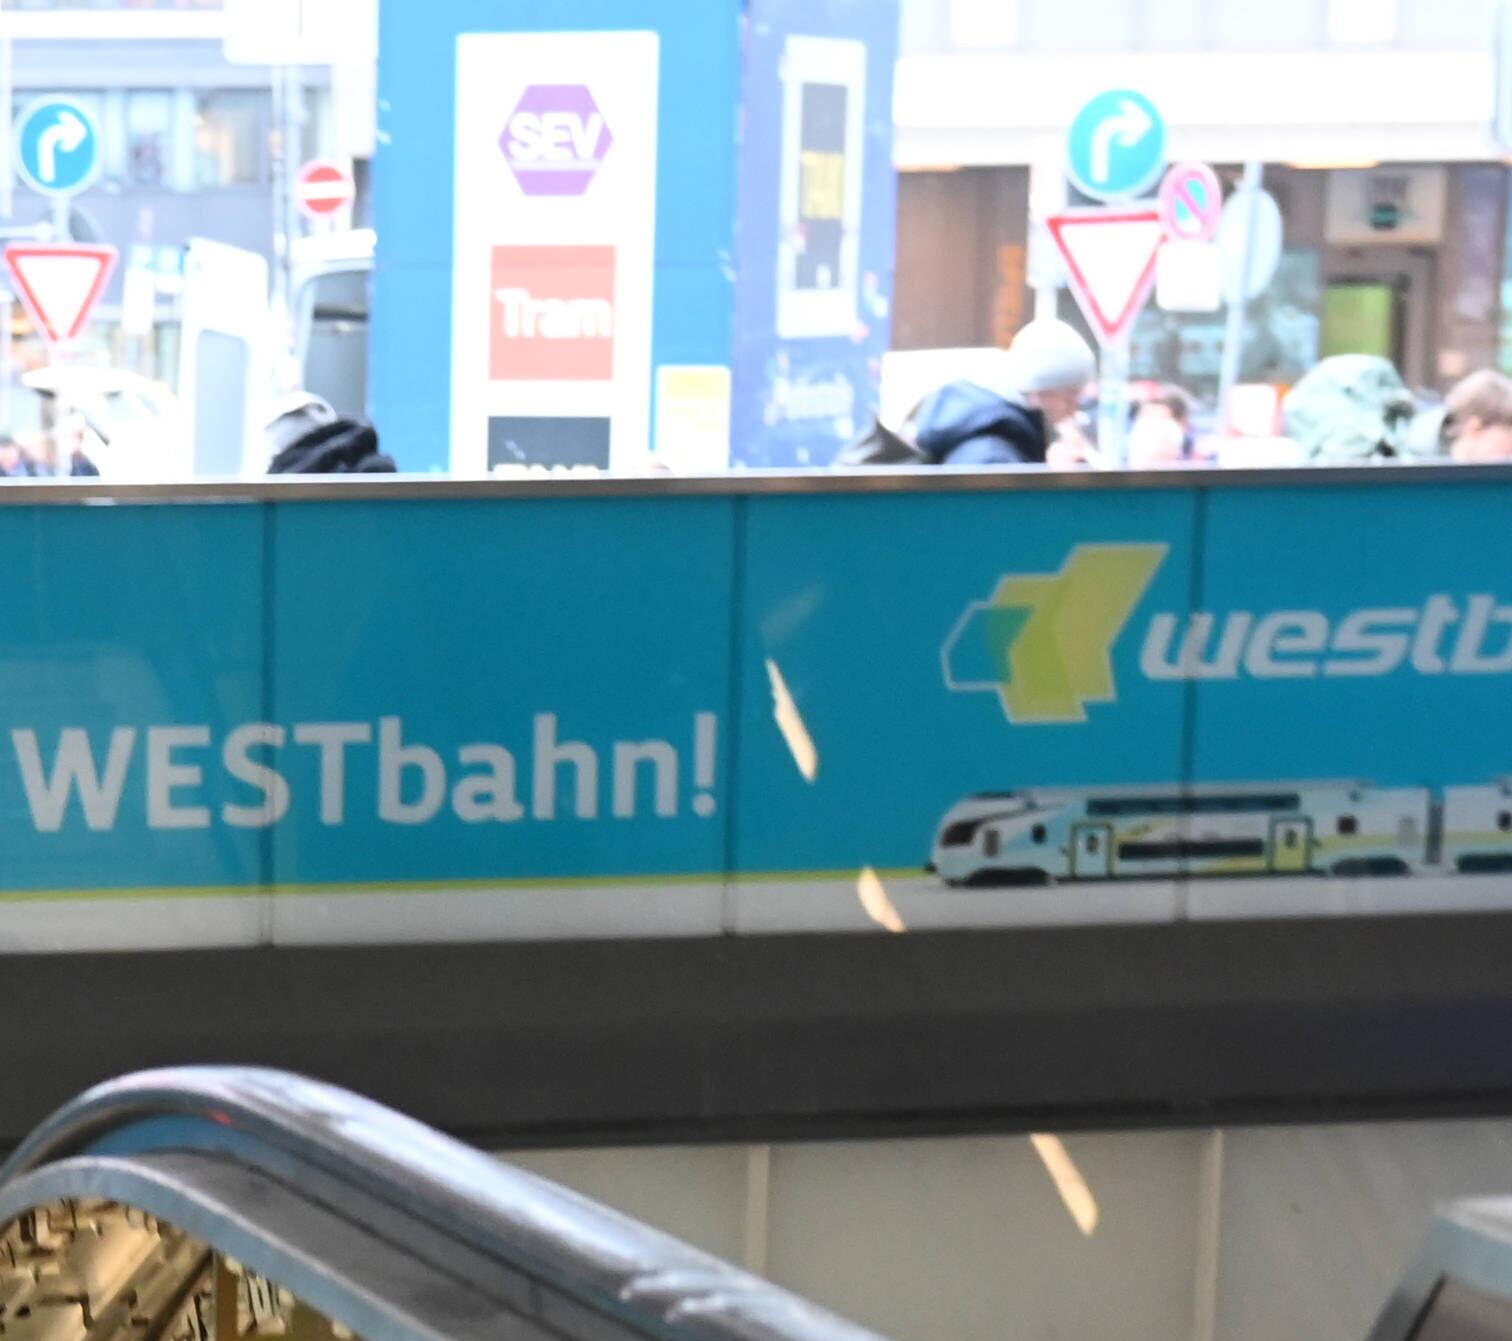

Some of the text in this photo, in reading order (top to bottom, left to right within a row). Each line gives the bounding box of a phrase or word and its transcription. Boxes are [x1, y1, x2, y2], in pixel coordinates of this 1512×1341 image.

[507, 112, 606, 161] SEV
[493, 287, 613, 339] Tram
[13, 714, 719, 834] WESTbahn!
